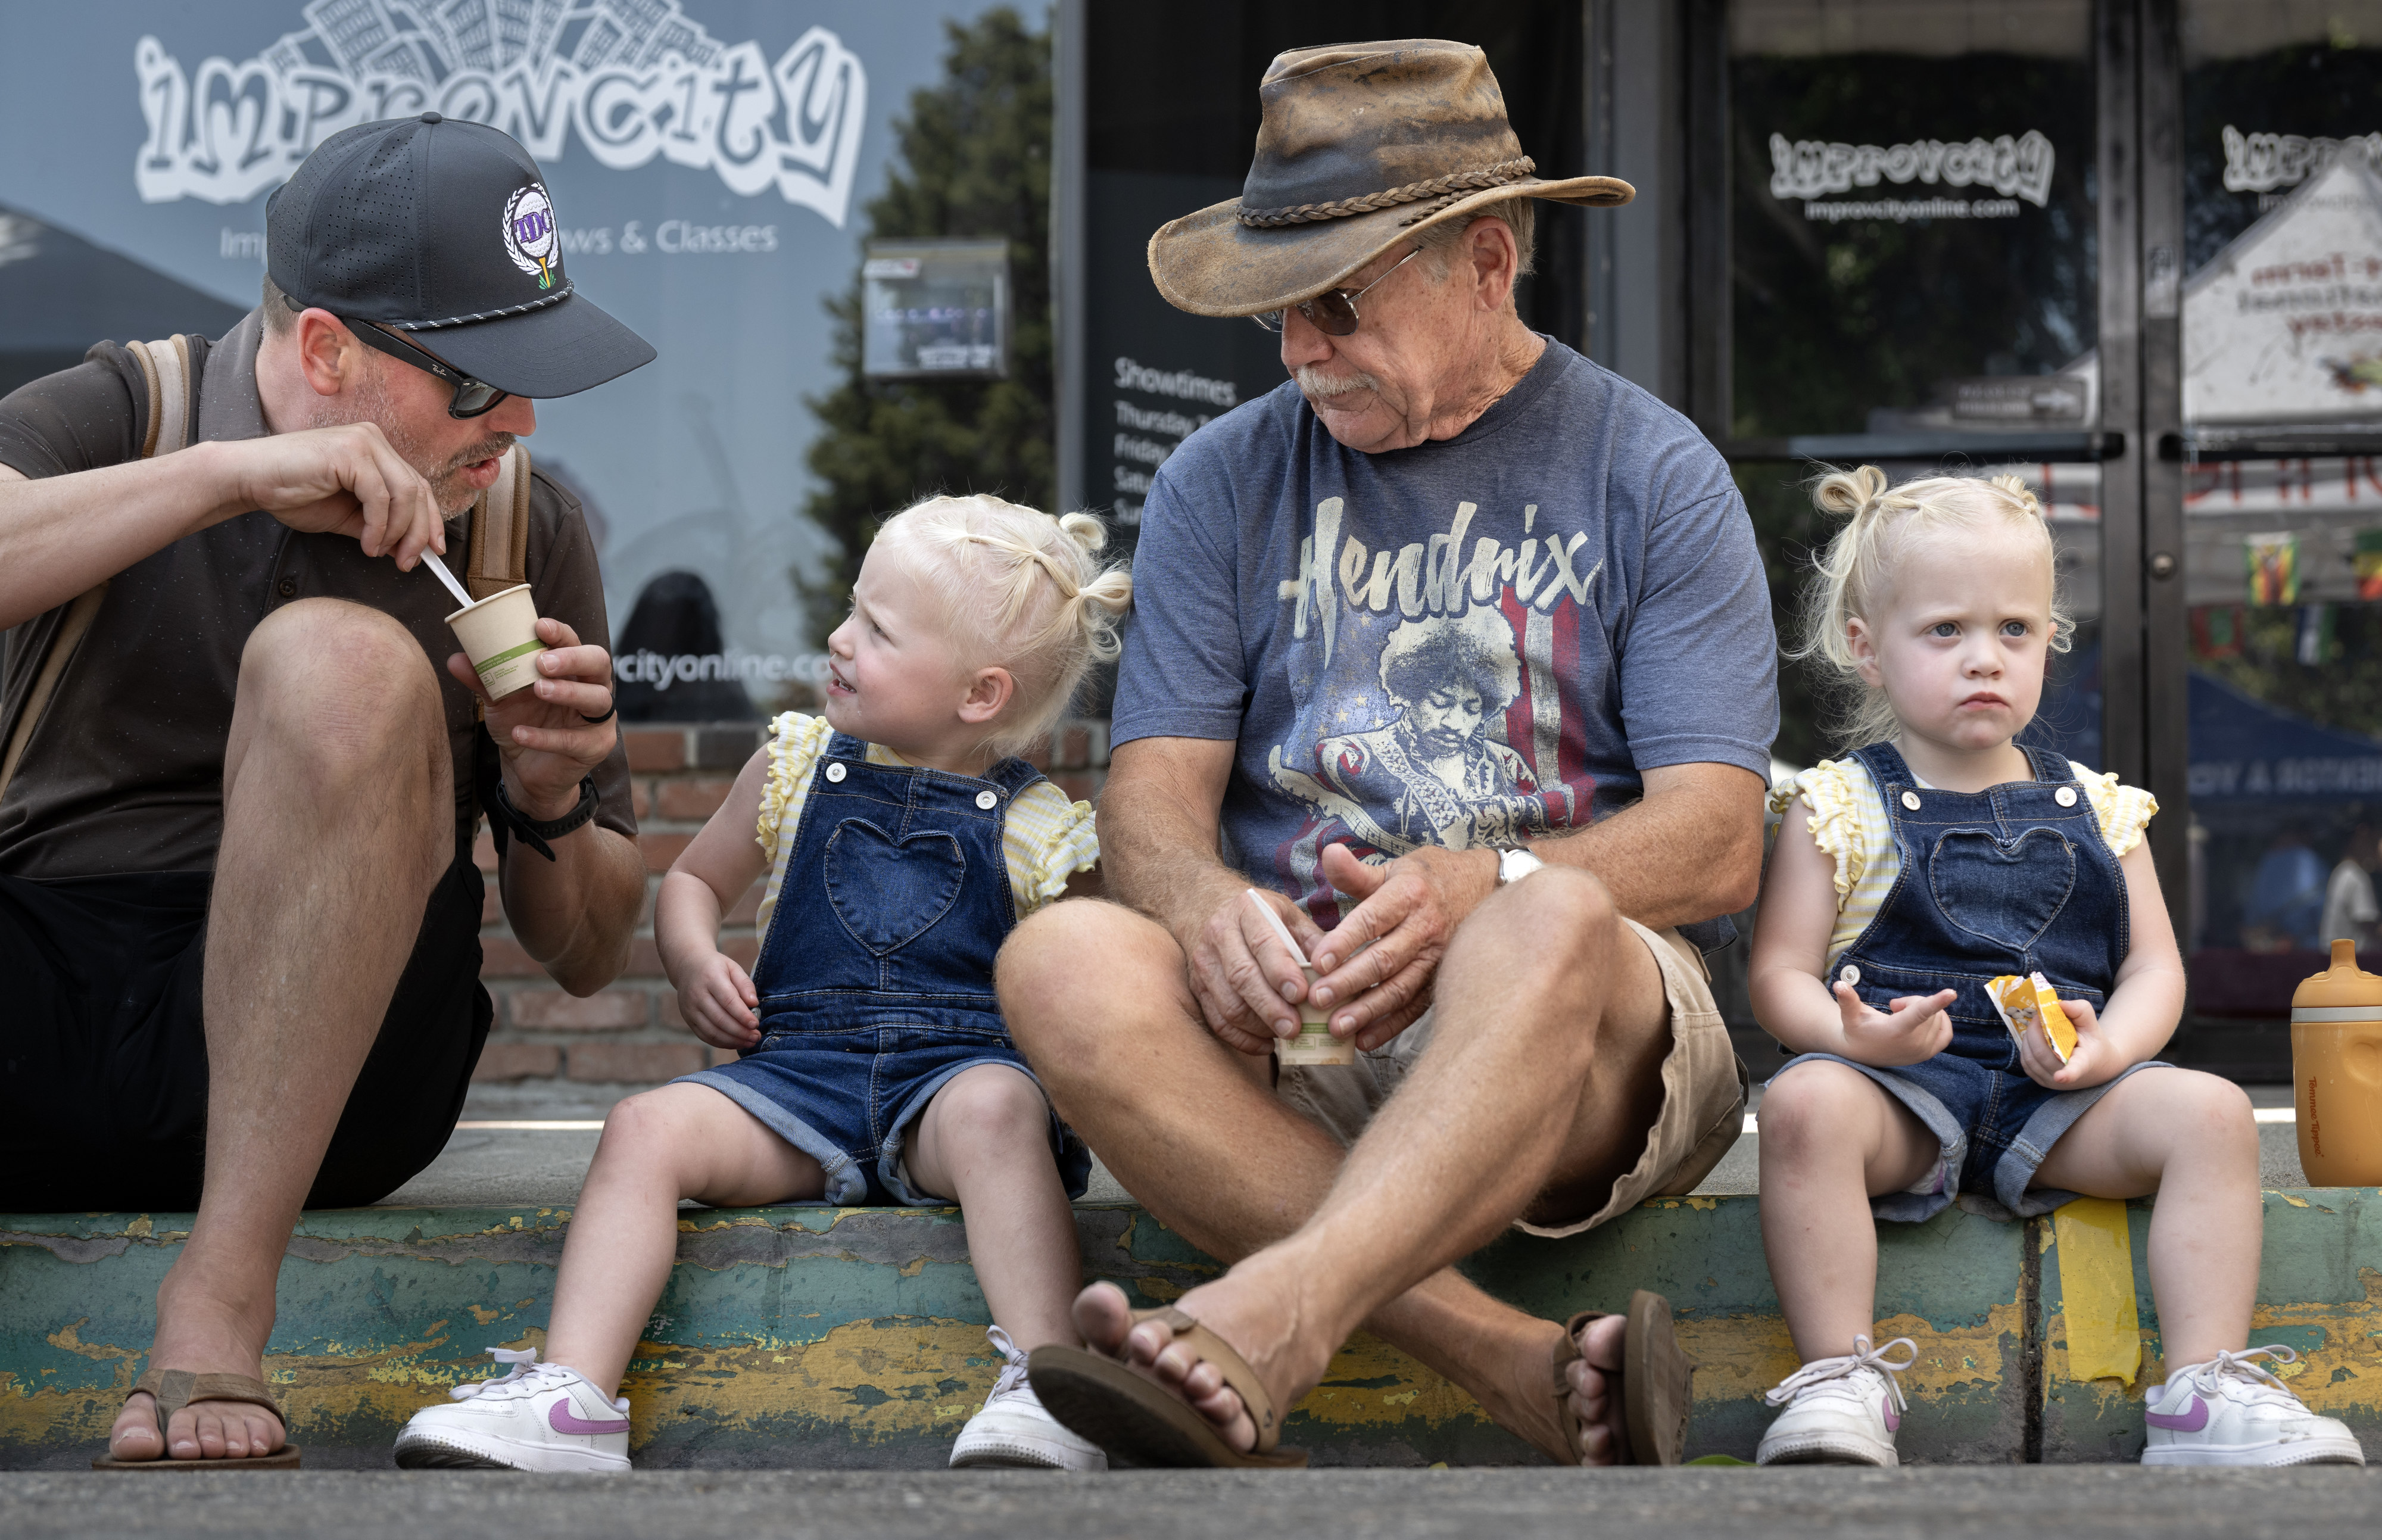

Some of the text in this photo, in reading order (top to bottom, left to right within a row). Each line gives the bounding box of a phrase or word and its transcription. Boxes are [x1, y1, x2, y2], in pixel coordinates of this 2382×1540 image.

[513, 208, 552, 244] TDC
[1805, 197, 2020, 224] improvcityonline.com
[620, 220, 648, 254] &
[656, 219, 779, 254] Classes
[1114, 357, 1237, 407] Showtimes
[1114, 400, 1196, 441] Thursday
[1277, 496, 1603, 671] Hendrix
[615, 647, 830, 691] cityonline.co
[2309, 1076, 2321, 1156] Tommee Tippee
